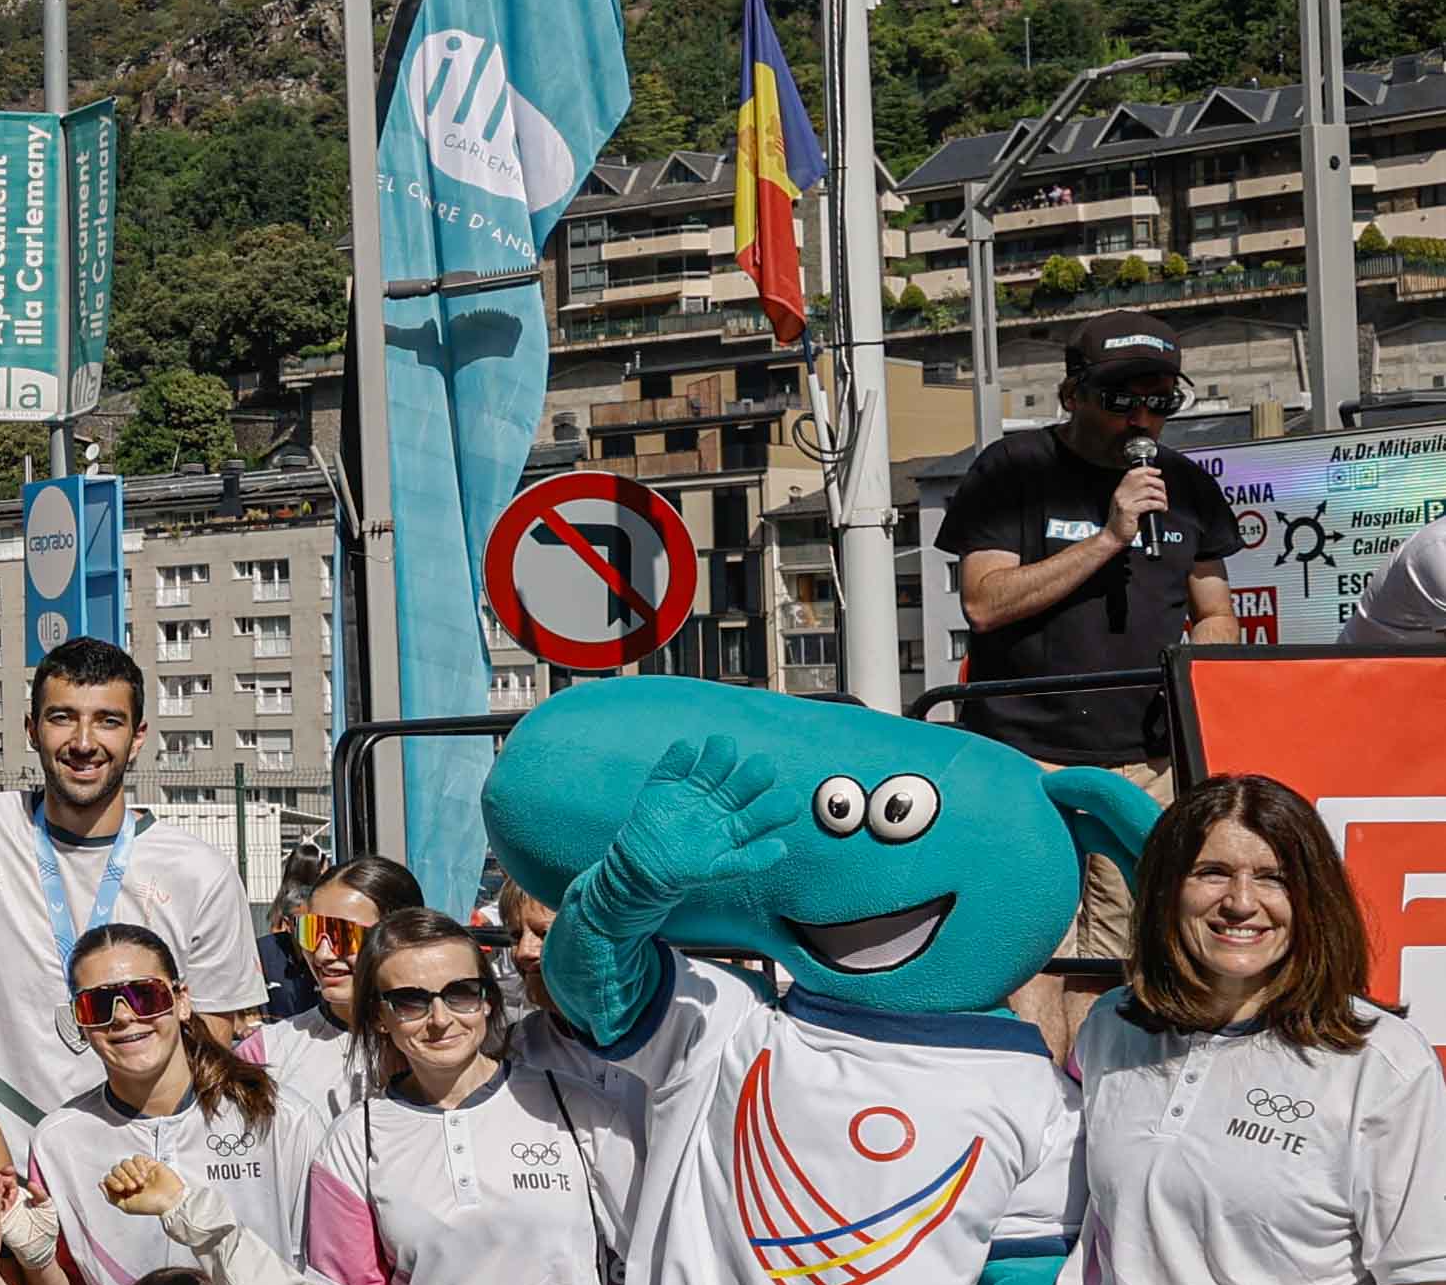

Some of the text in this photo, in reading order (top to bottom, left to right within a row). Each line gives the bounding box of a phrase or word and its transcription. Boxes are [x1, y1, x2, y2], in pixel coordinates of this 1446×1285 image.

[427, 35, 510, 143] ill
[443, 133, 521, 184] CARLEMA
[90, 113, 112, 285] Carlemany
[15, 123, 53, 347] illa Carlemany
[1223, 482, 1275, 506] SANA
[1351, 505, 1421, 528] Hospital
[28, 532, 74, 555] caprabo
[1352, 537, 1402, 556] Calde
[39, 611, 61, 640] illa
[1226, 1117, 1306, 1156] MOU-TE
[207, 1161, 260, 1181] MOU-TE
[512, 1173, 571, 1192] MOU-TE
